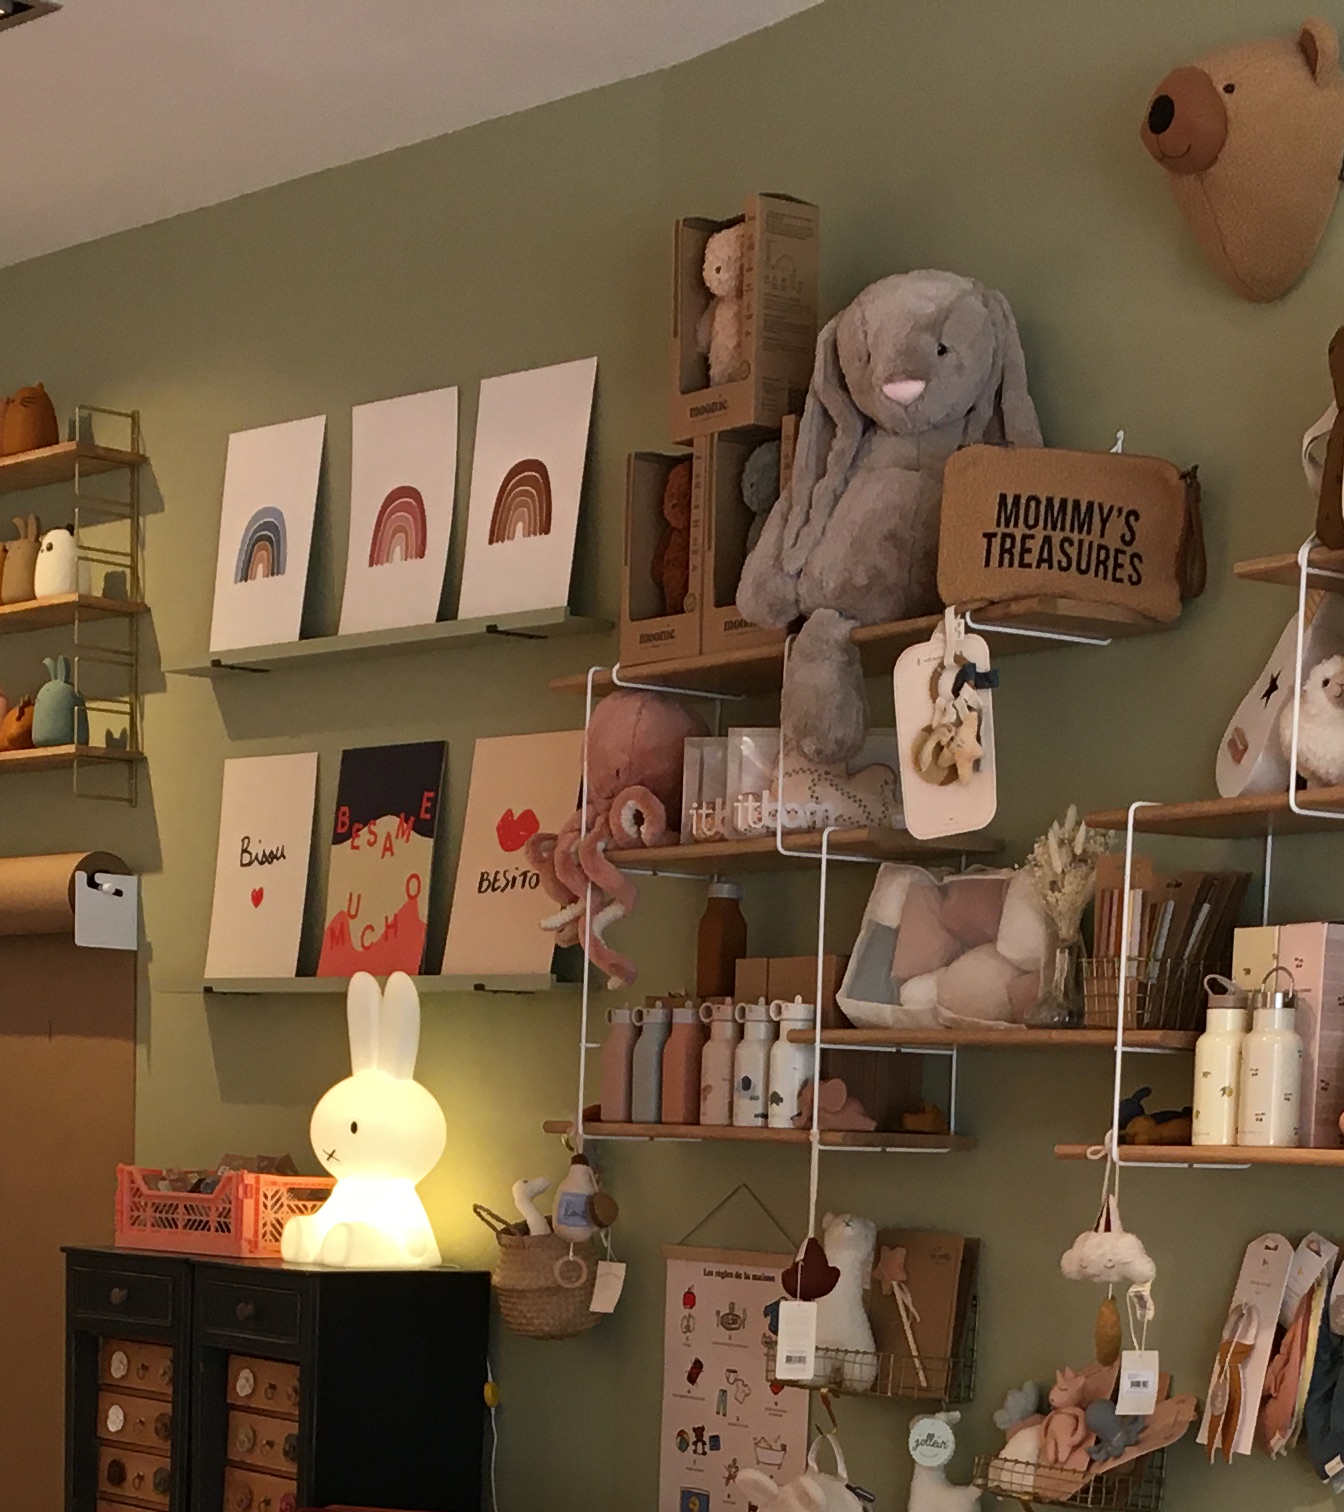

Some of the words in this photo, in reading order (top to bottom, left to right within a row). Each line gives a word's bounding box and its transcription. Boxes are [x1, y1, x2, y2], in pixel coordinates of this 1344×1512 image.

[996, 493, 1140, 547] MOMMY'S
[982, 531, 1144, 586] TREASURES
[240, 835, 286, 867] Bisou
